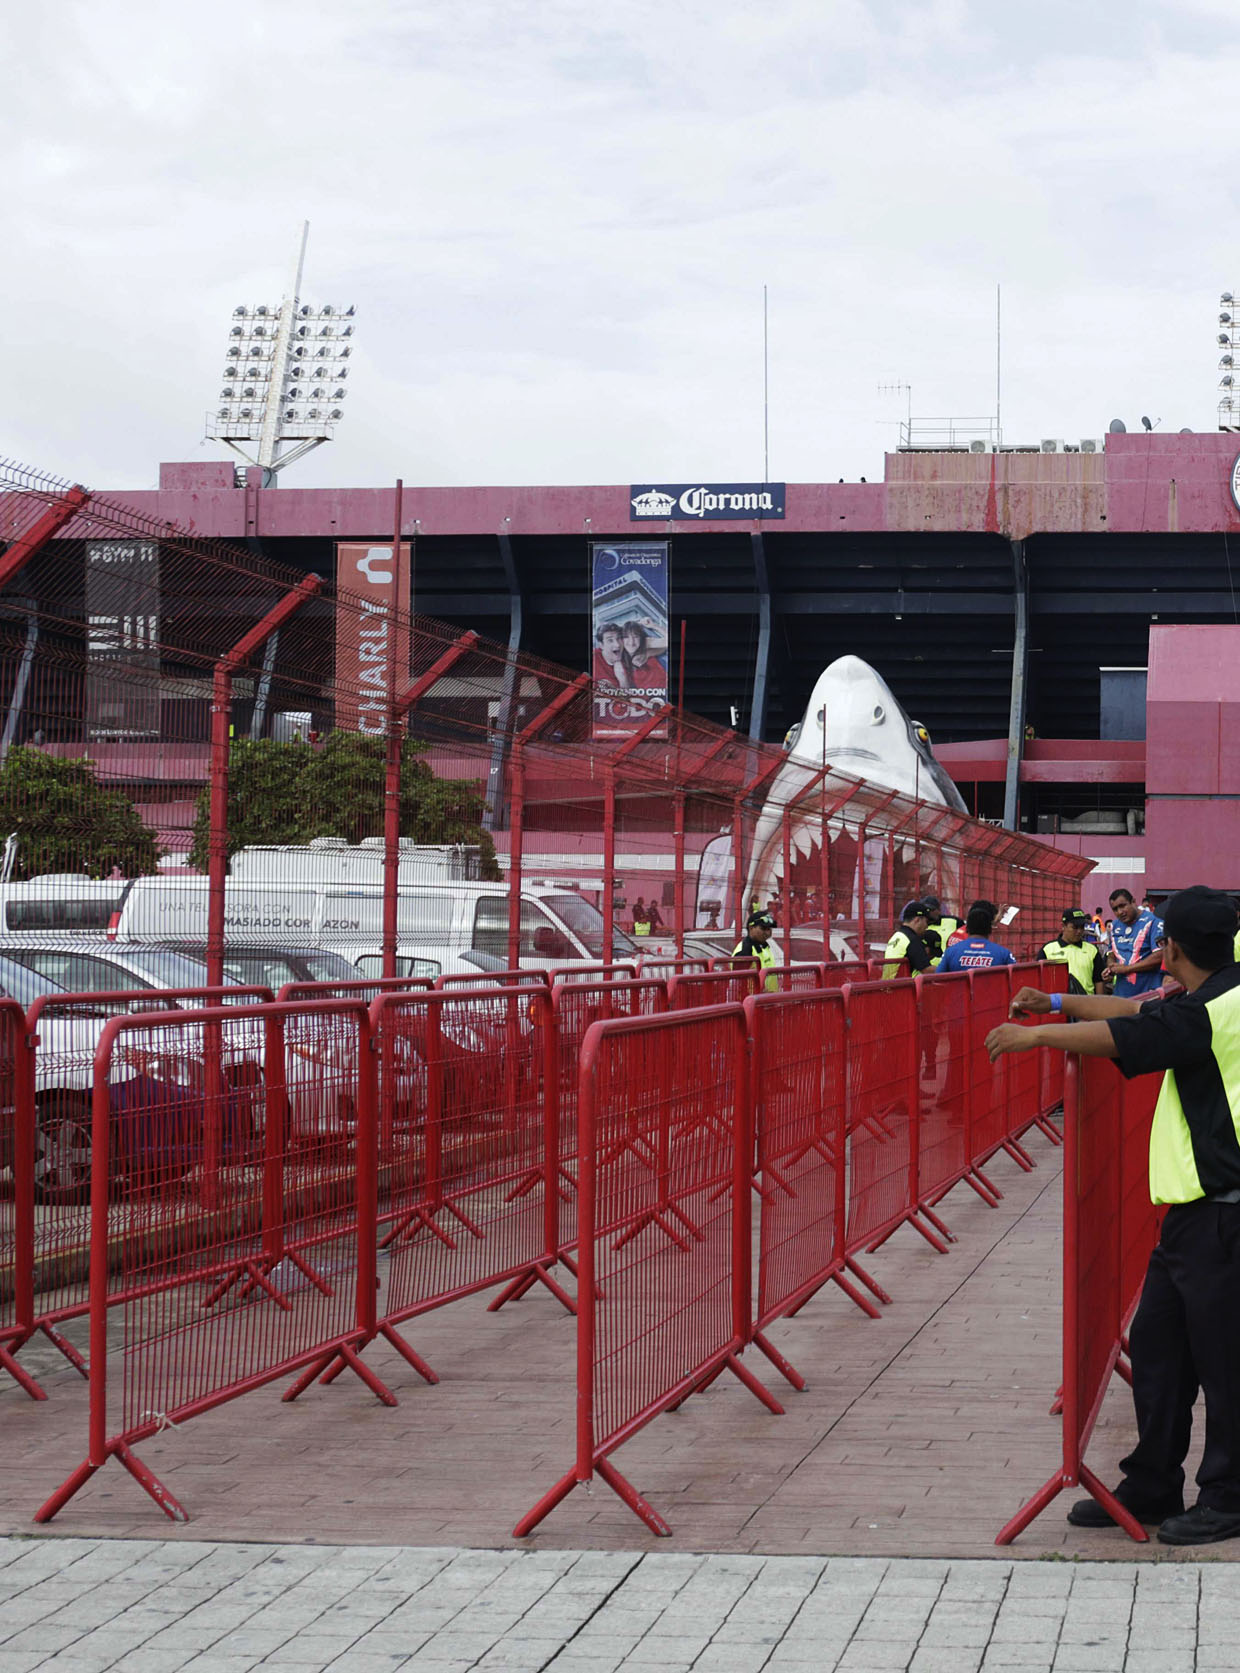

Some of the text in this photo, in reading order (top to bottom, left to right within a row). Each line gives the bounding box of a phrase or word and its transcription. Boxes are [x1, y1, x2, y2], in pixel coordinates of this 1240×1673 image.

[679, 487, 774, 517] Corona
[621, 556, 662, 567] Covadonga
[594, 577, 628, 596] HOSPITAL
[358, 599, 388, 736] CHARLY
[646, 688, 666, 696] CON
[159, 902, 186, 912] UNA
[189, 903, 259, 913] TELSORA
[960, 956, 993, 967] TECATE
